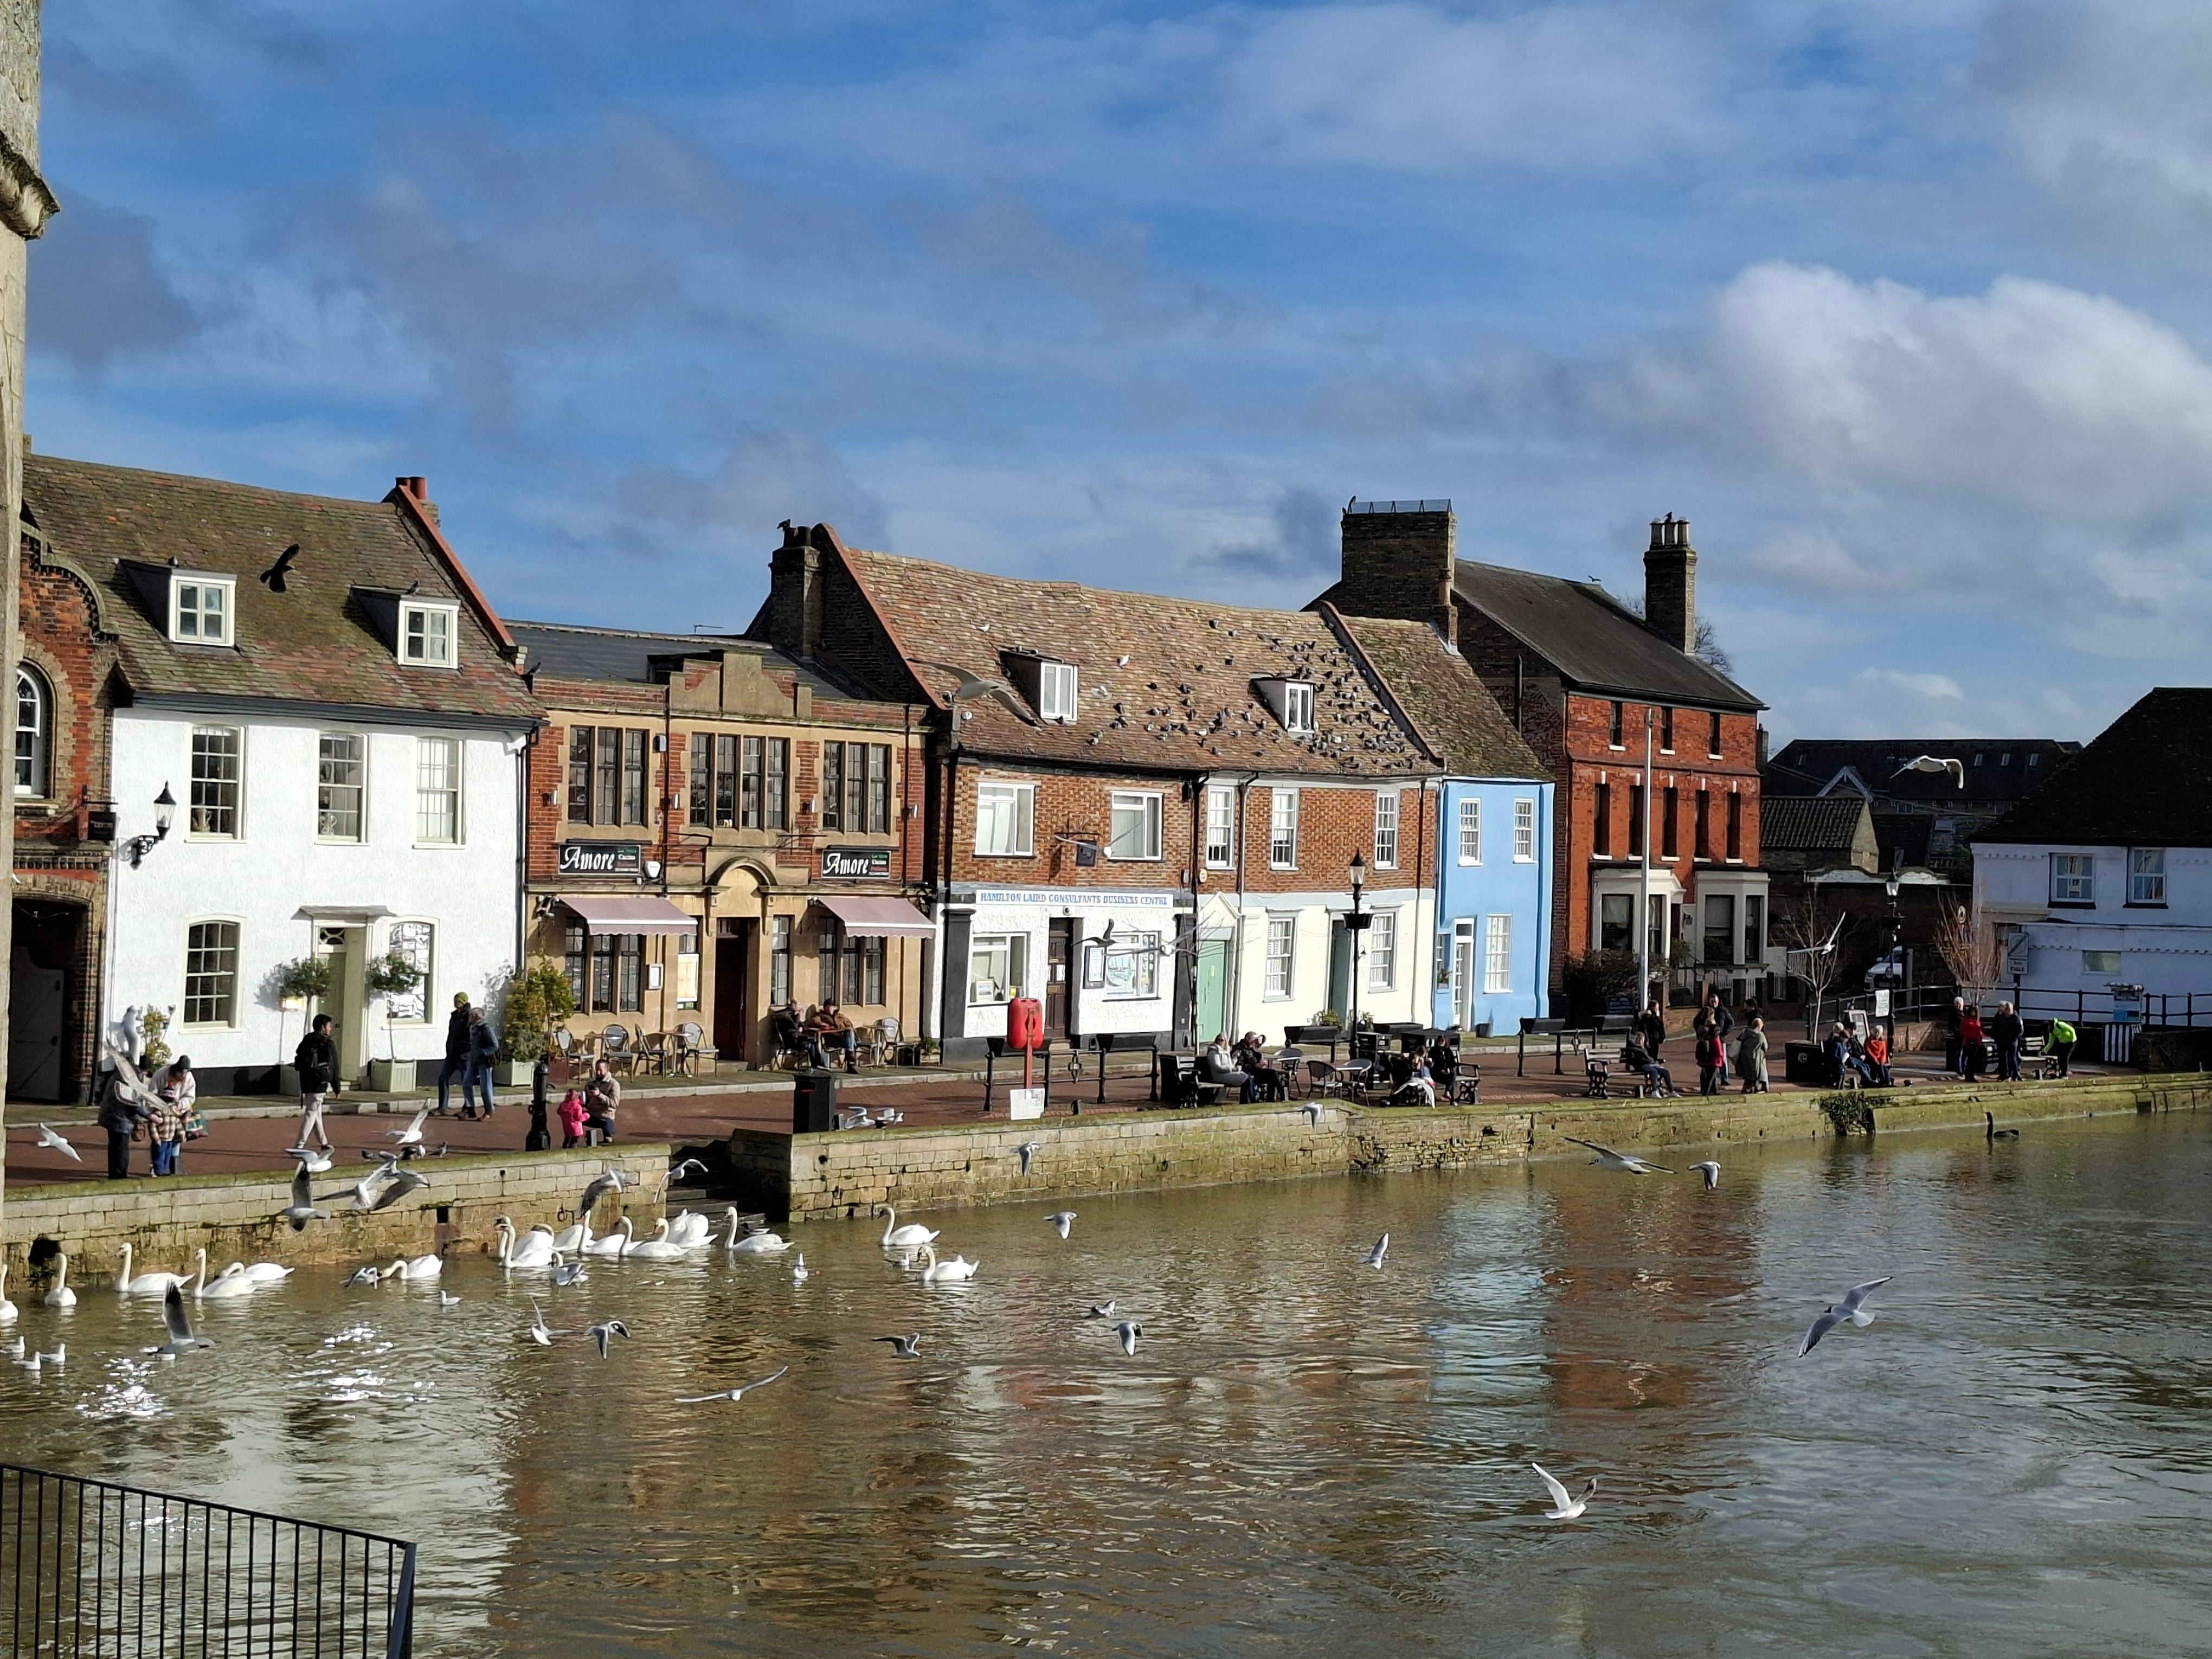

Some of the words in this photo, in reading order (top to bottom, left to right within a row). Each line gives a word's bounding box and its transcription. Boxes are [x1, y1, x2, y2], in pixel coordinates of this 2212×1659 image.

[560, 846, 615, 870] Amore
[822, 852, 869, 875] Amore
[980, 892, 1021, 902] HAMILTON
[1049, 894, 1101, 904] CONSULTANTS
[1103, 895, 1138, 904] BUSINESS
[1141, 896, 1168, 905] CENTRE
